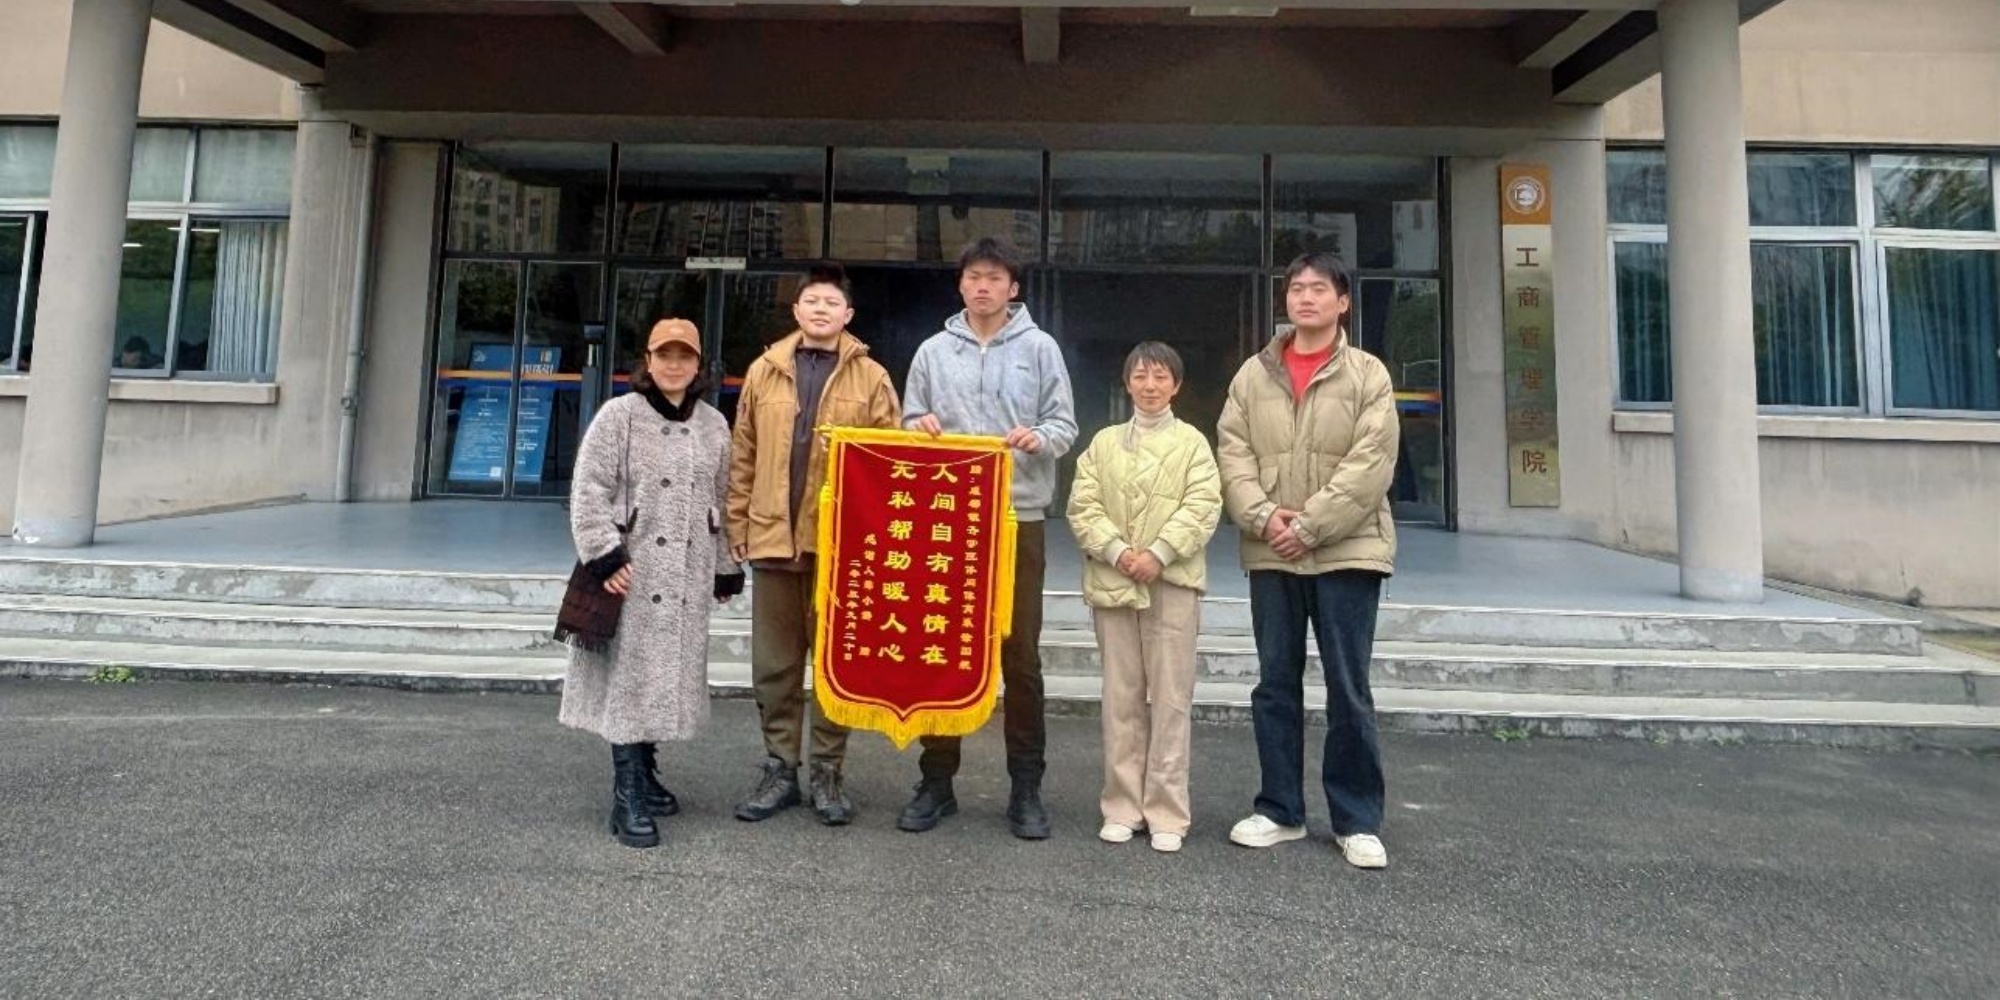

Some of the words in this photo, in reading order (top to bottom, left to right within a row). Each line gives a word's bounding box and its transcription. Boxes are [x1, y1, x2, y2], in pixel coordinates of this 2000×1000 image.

[1516, 247, 1547, 474] 工商管理学院
[878, 461, 917, 662] 无私帮助暖人心
[920, 464, 958, 665] 人间自有真情在
